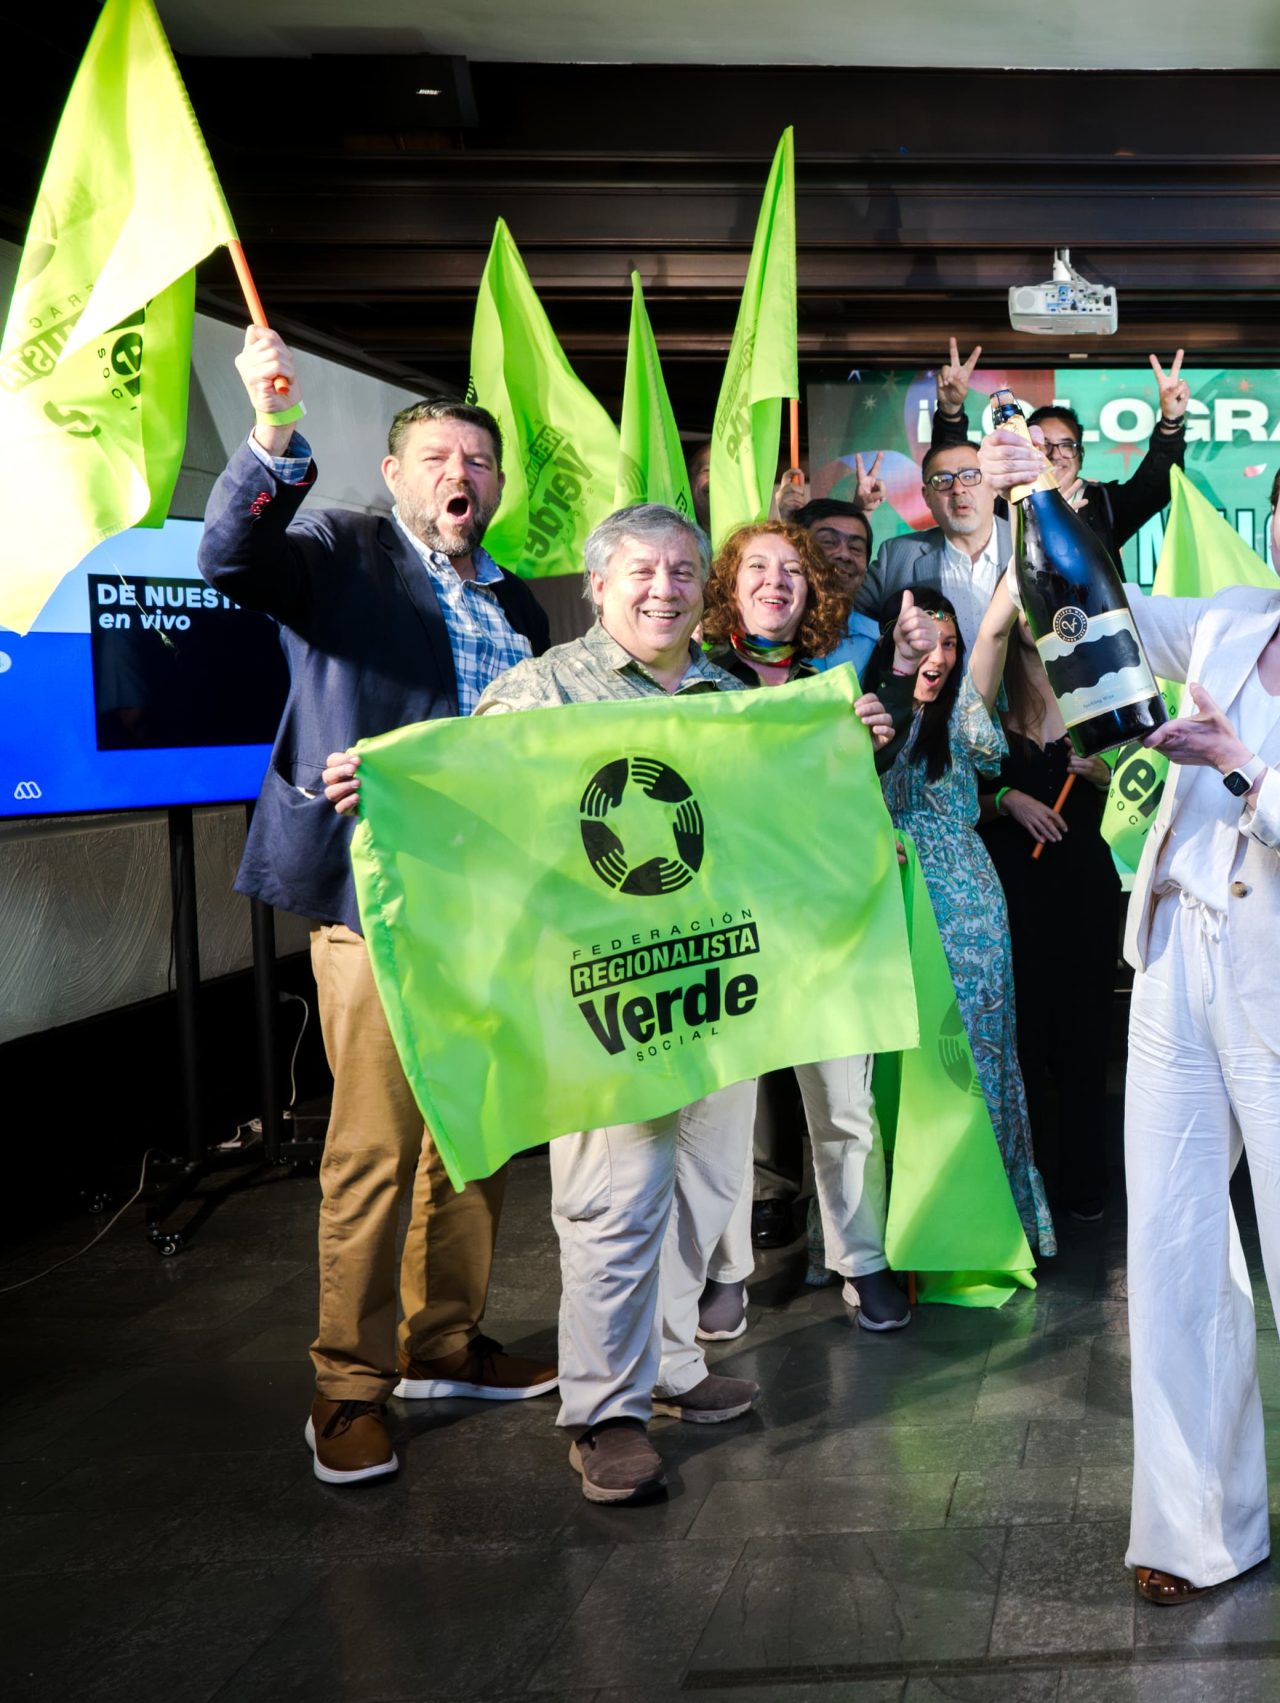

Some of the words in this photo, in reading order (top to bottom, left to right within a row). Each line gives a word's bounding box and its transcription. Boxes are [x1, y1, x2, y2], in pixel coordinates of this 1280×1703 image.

[97, 583, 136, 606] DE
[99, 611, 130, 629] en
[140, 609, 191, 631] vivo
[1109, 787, 1149, 836] SOCI
[573, 909, 752, 960] FEDERACIÓN
[572, 926, 757, 994] REGIONALISTA
[578, 967, 758, 1055] Verde
[637, 1027, 718, 1062] SOCIAL
